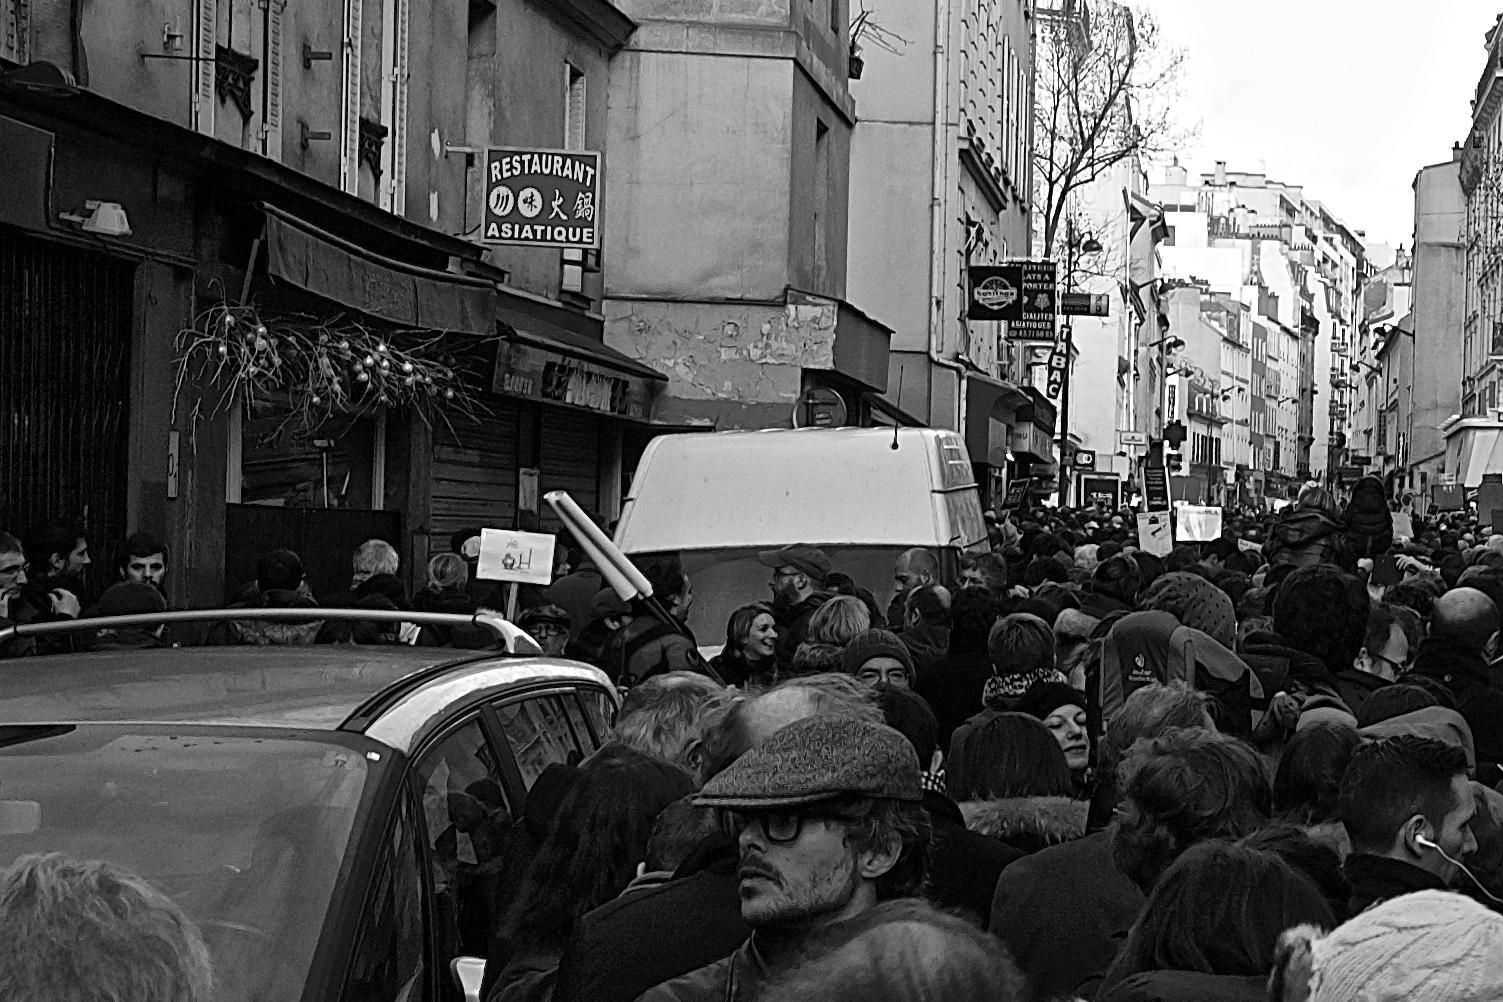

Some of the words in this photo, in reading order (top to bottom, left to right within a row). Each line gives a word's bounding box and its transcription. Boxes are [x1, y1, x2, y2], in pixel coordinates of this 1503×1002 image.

[490, 153, 595, 187] RESTAURANT
[486, 222, 595, 243] ASIATIQUE
[1048, 327, 1070, 397] TABAC
